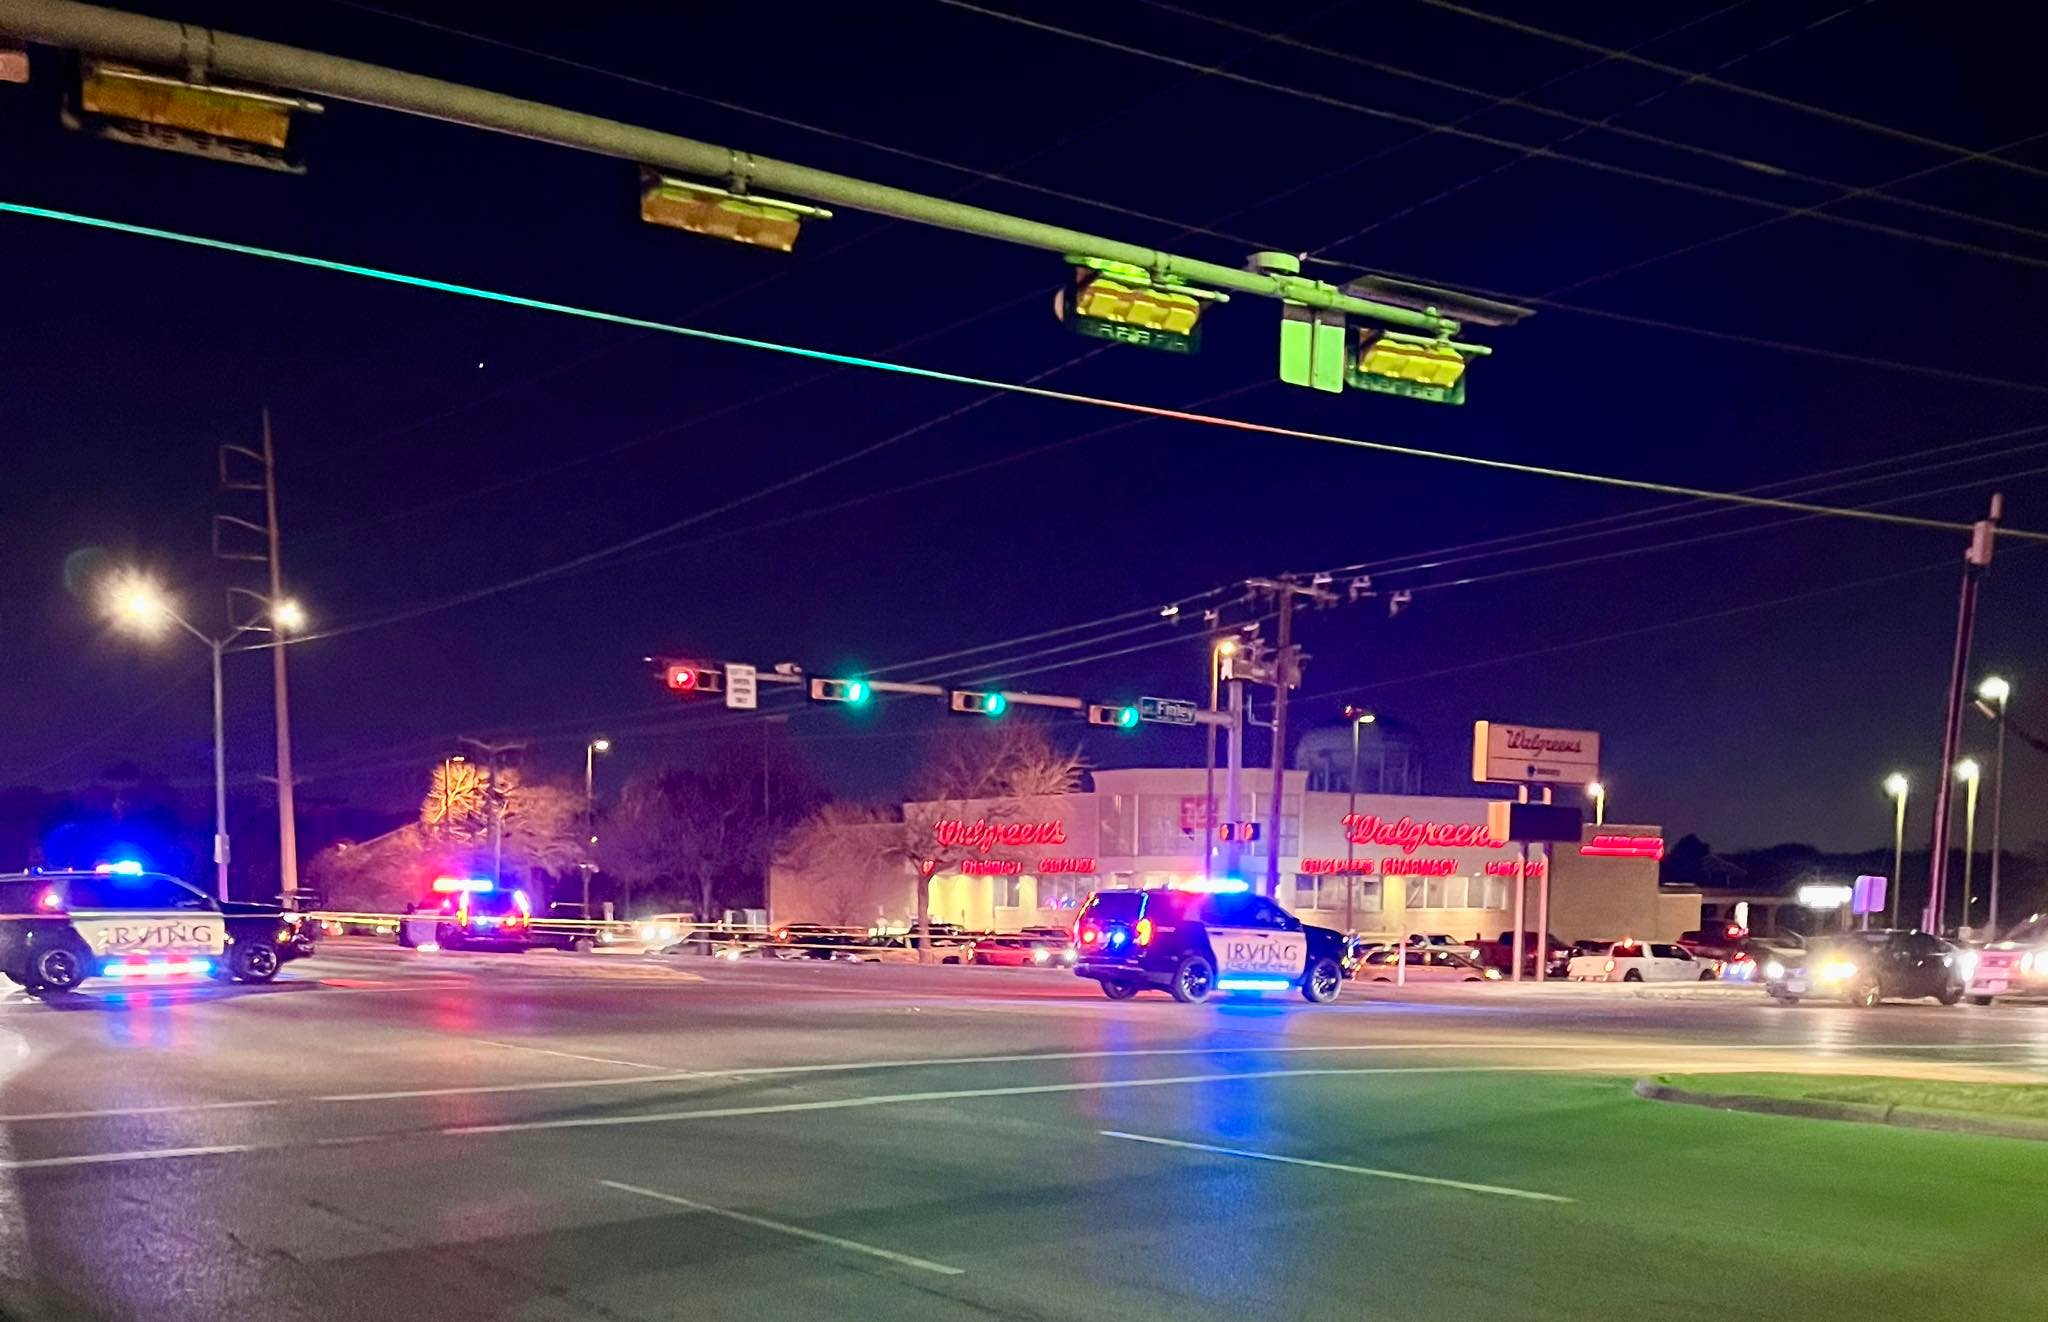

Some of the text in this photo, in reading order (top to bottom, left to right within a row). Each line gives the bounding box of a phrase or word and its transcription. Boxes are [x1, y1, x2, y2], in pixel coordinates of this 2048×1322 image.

[1157, 701, 1194, 722] Finley
[1506, 730, 1582, 757] Walgreens
[935, 819, 1067, 853] Walgreens
[1382, 858, 1459, 876] PHARMACY
[105, 924, 212, 945] IRVING
[1227, 942, 1297, 962] IRVING
